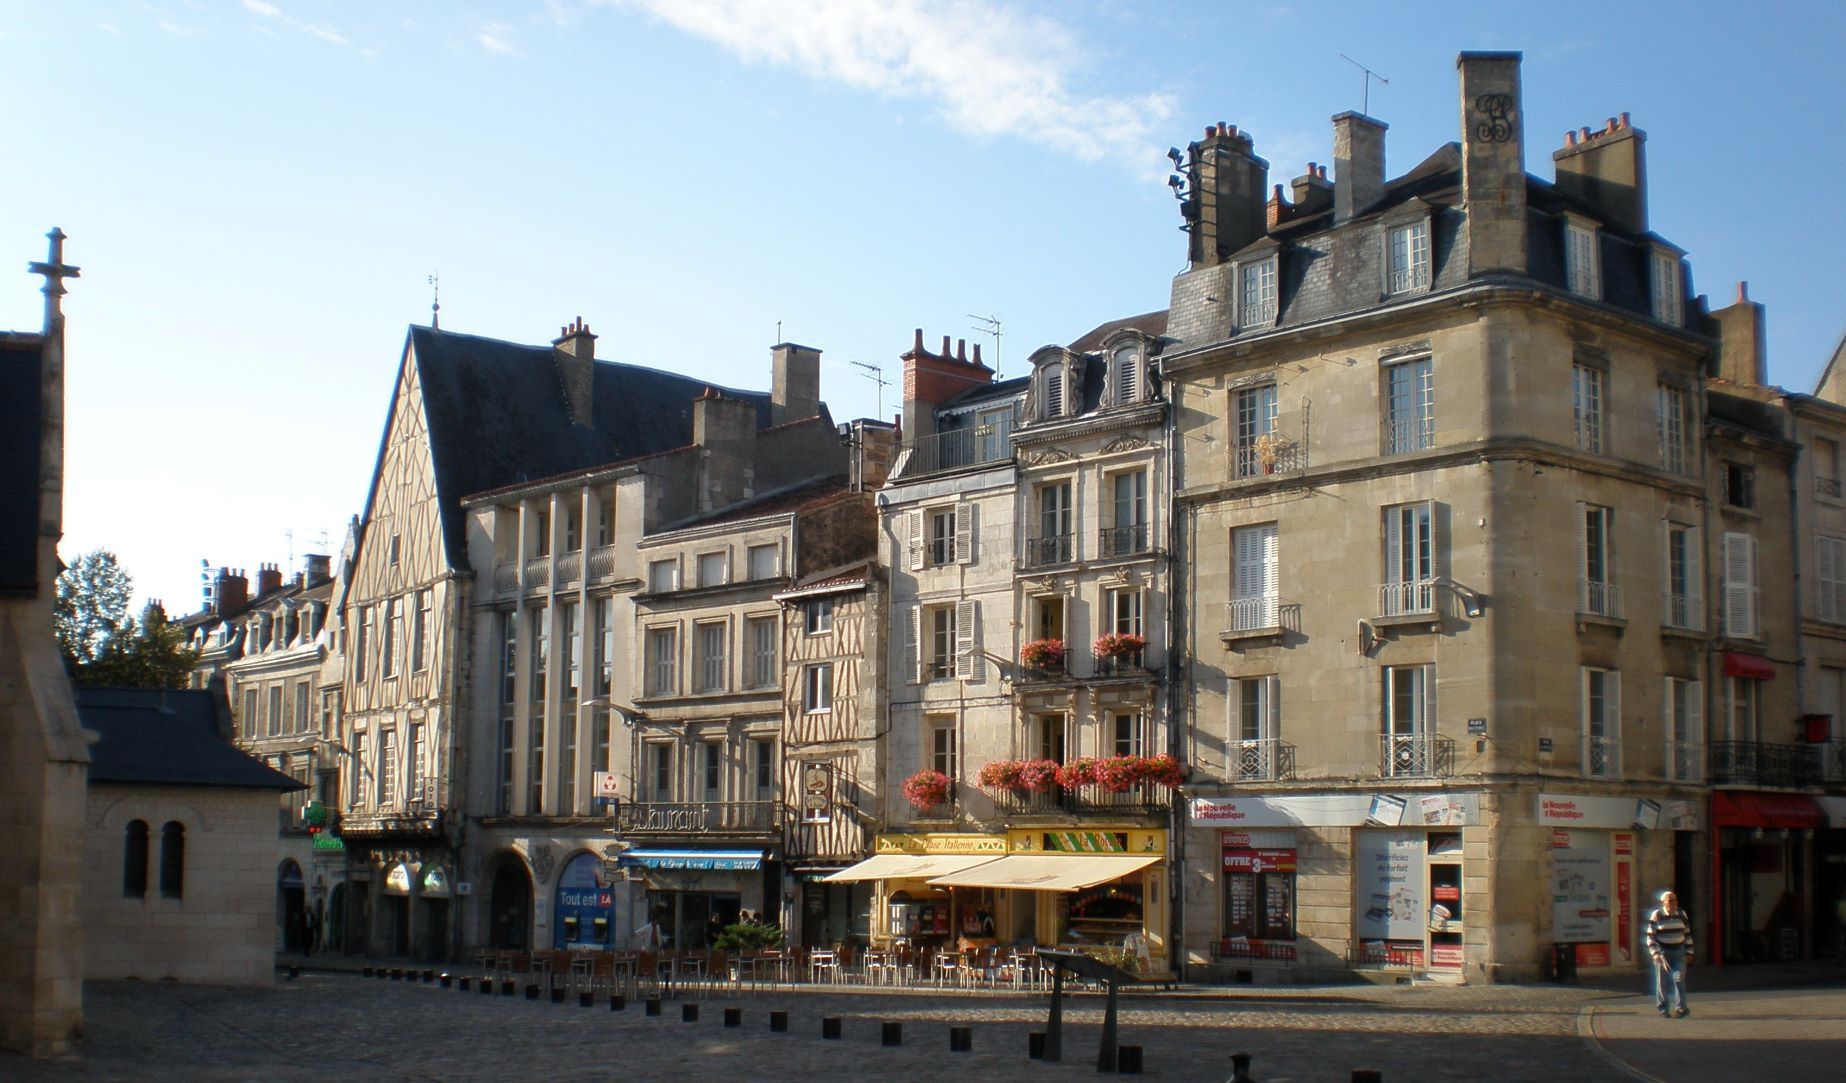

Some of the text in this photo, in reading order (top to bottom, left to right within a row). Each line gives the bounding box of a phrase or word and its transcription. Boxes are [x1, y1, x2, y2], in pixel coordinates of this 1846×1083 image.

[1204, 803, 1236, 811] Nouvelle
[1550, 800, 1577, 809] Nouvelle
[1204, 811, 1246, 820] République
[1550, 809, 1584, 819] République
[1225, 856, 1250, 866] OFFRE
[1253, 858, 1261, 873] 3
[560, 892, 580, 906] Tout
[582, 893, 597, 906] est
